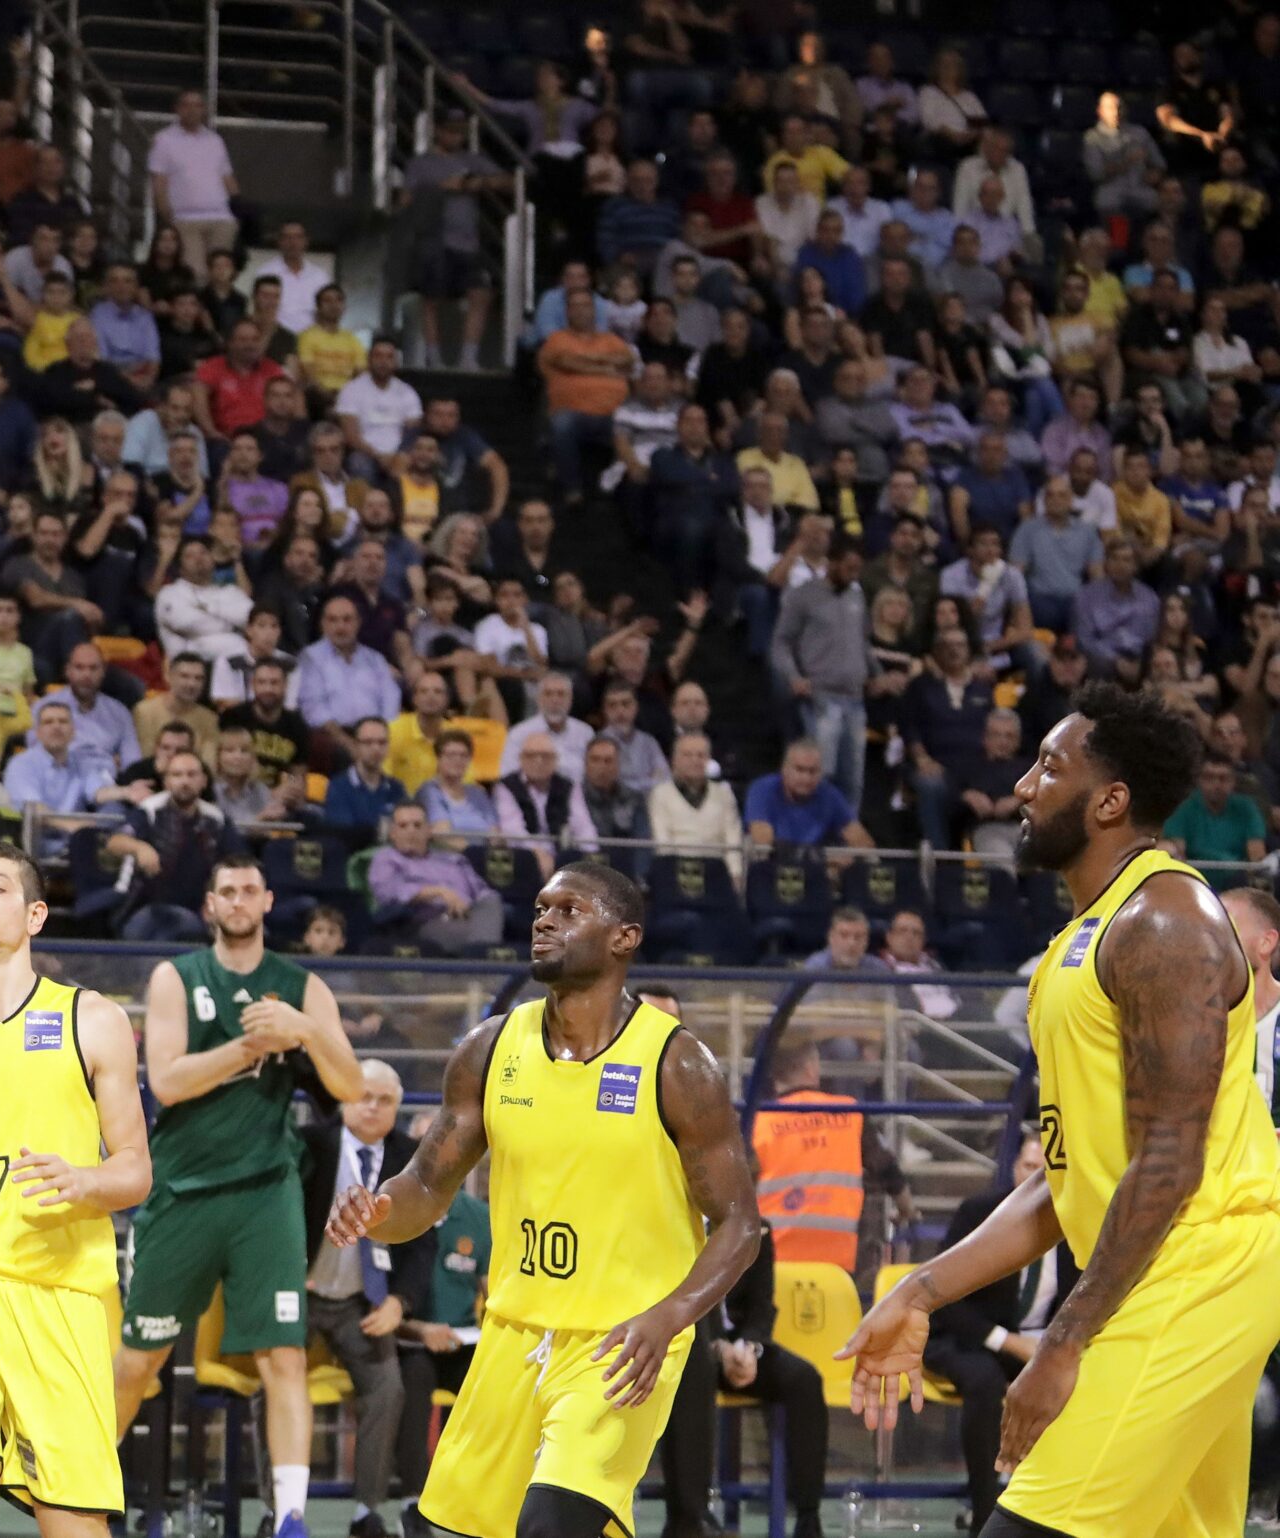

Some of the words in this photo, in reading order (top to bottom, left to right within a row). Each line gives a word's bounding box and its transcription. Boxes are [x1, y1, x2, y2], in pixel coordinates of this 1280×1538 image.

[193, 986, 217, 1022] 6
[499, 1095, 533, 1108] SPALDING
[520, 1217, 578, 1280] 10
